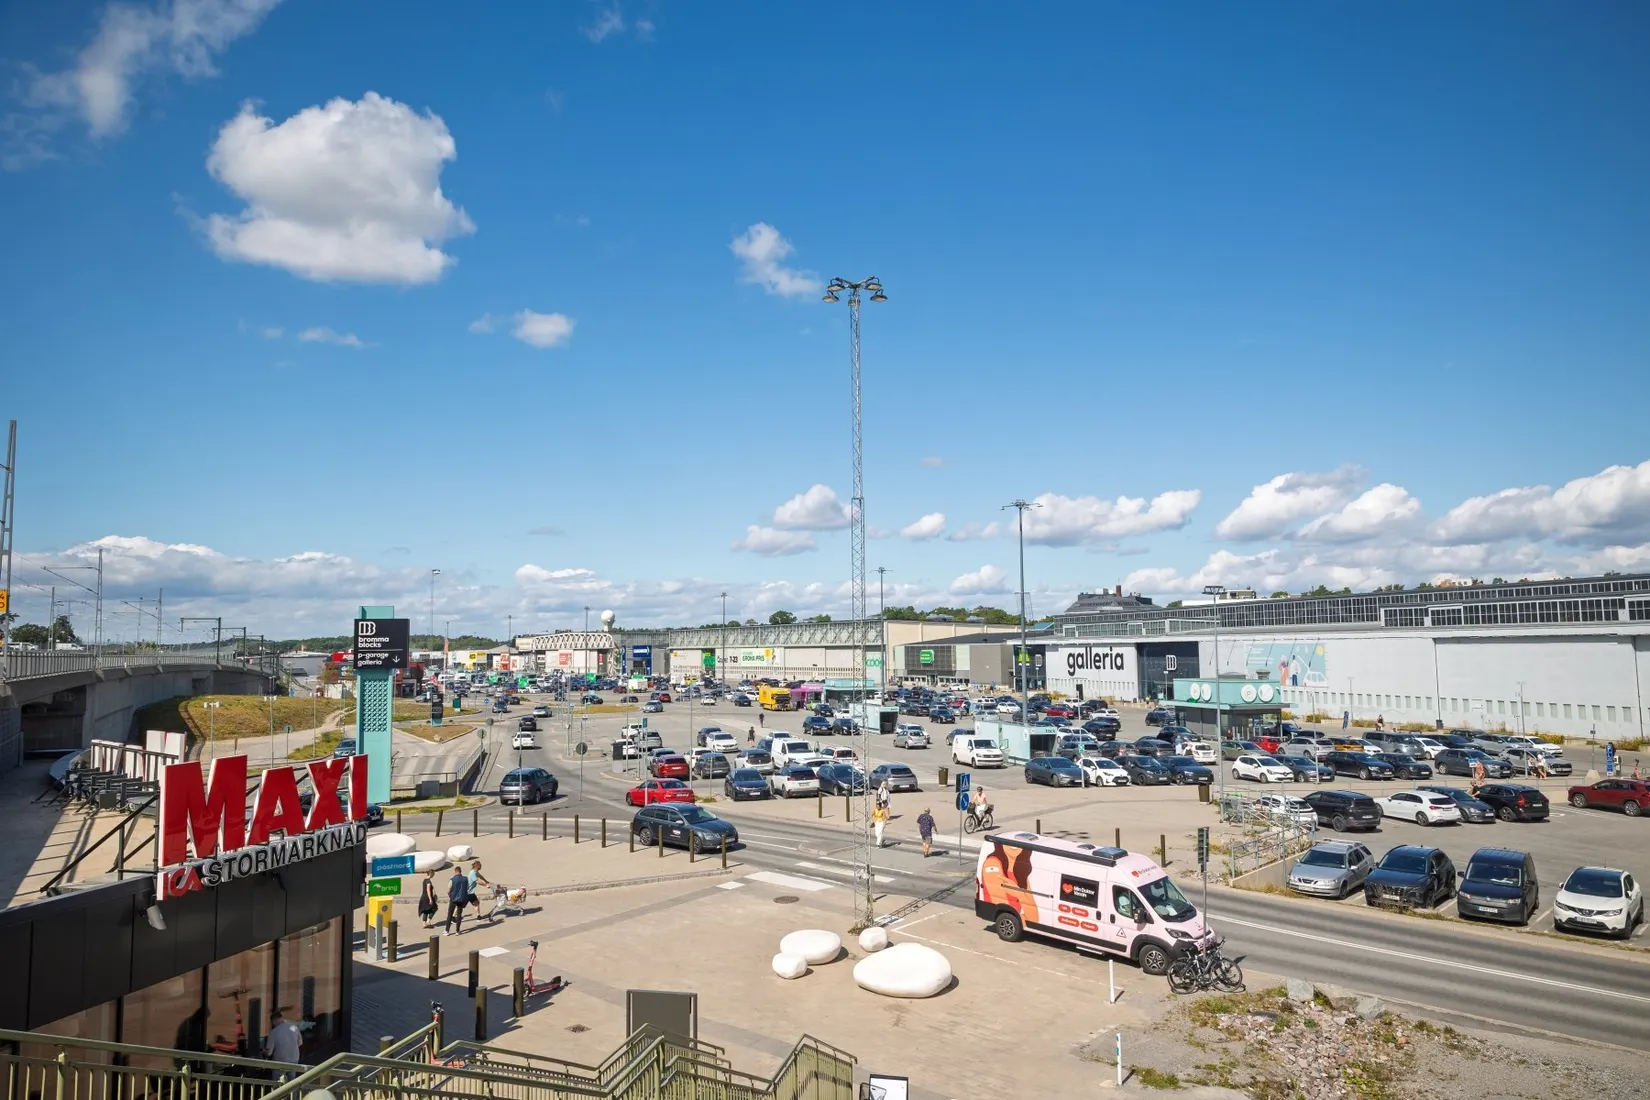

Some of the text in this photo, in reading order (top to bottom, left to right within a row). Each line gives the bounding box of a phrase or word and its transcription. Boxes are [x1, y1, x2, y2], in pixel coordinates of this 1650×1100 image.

[357, 652, 389, 660] p-garage
[1067, 646, 1125, 676] galleria
[160, 754, 369, 867] MAXI
[157, 824, 368, 900] ICA STORMARKNAD
[376, 861, 411, 871] postnord
[381, 884, 398, 892] bring
